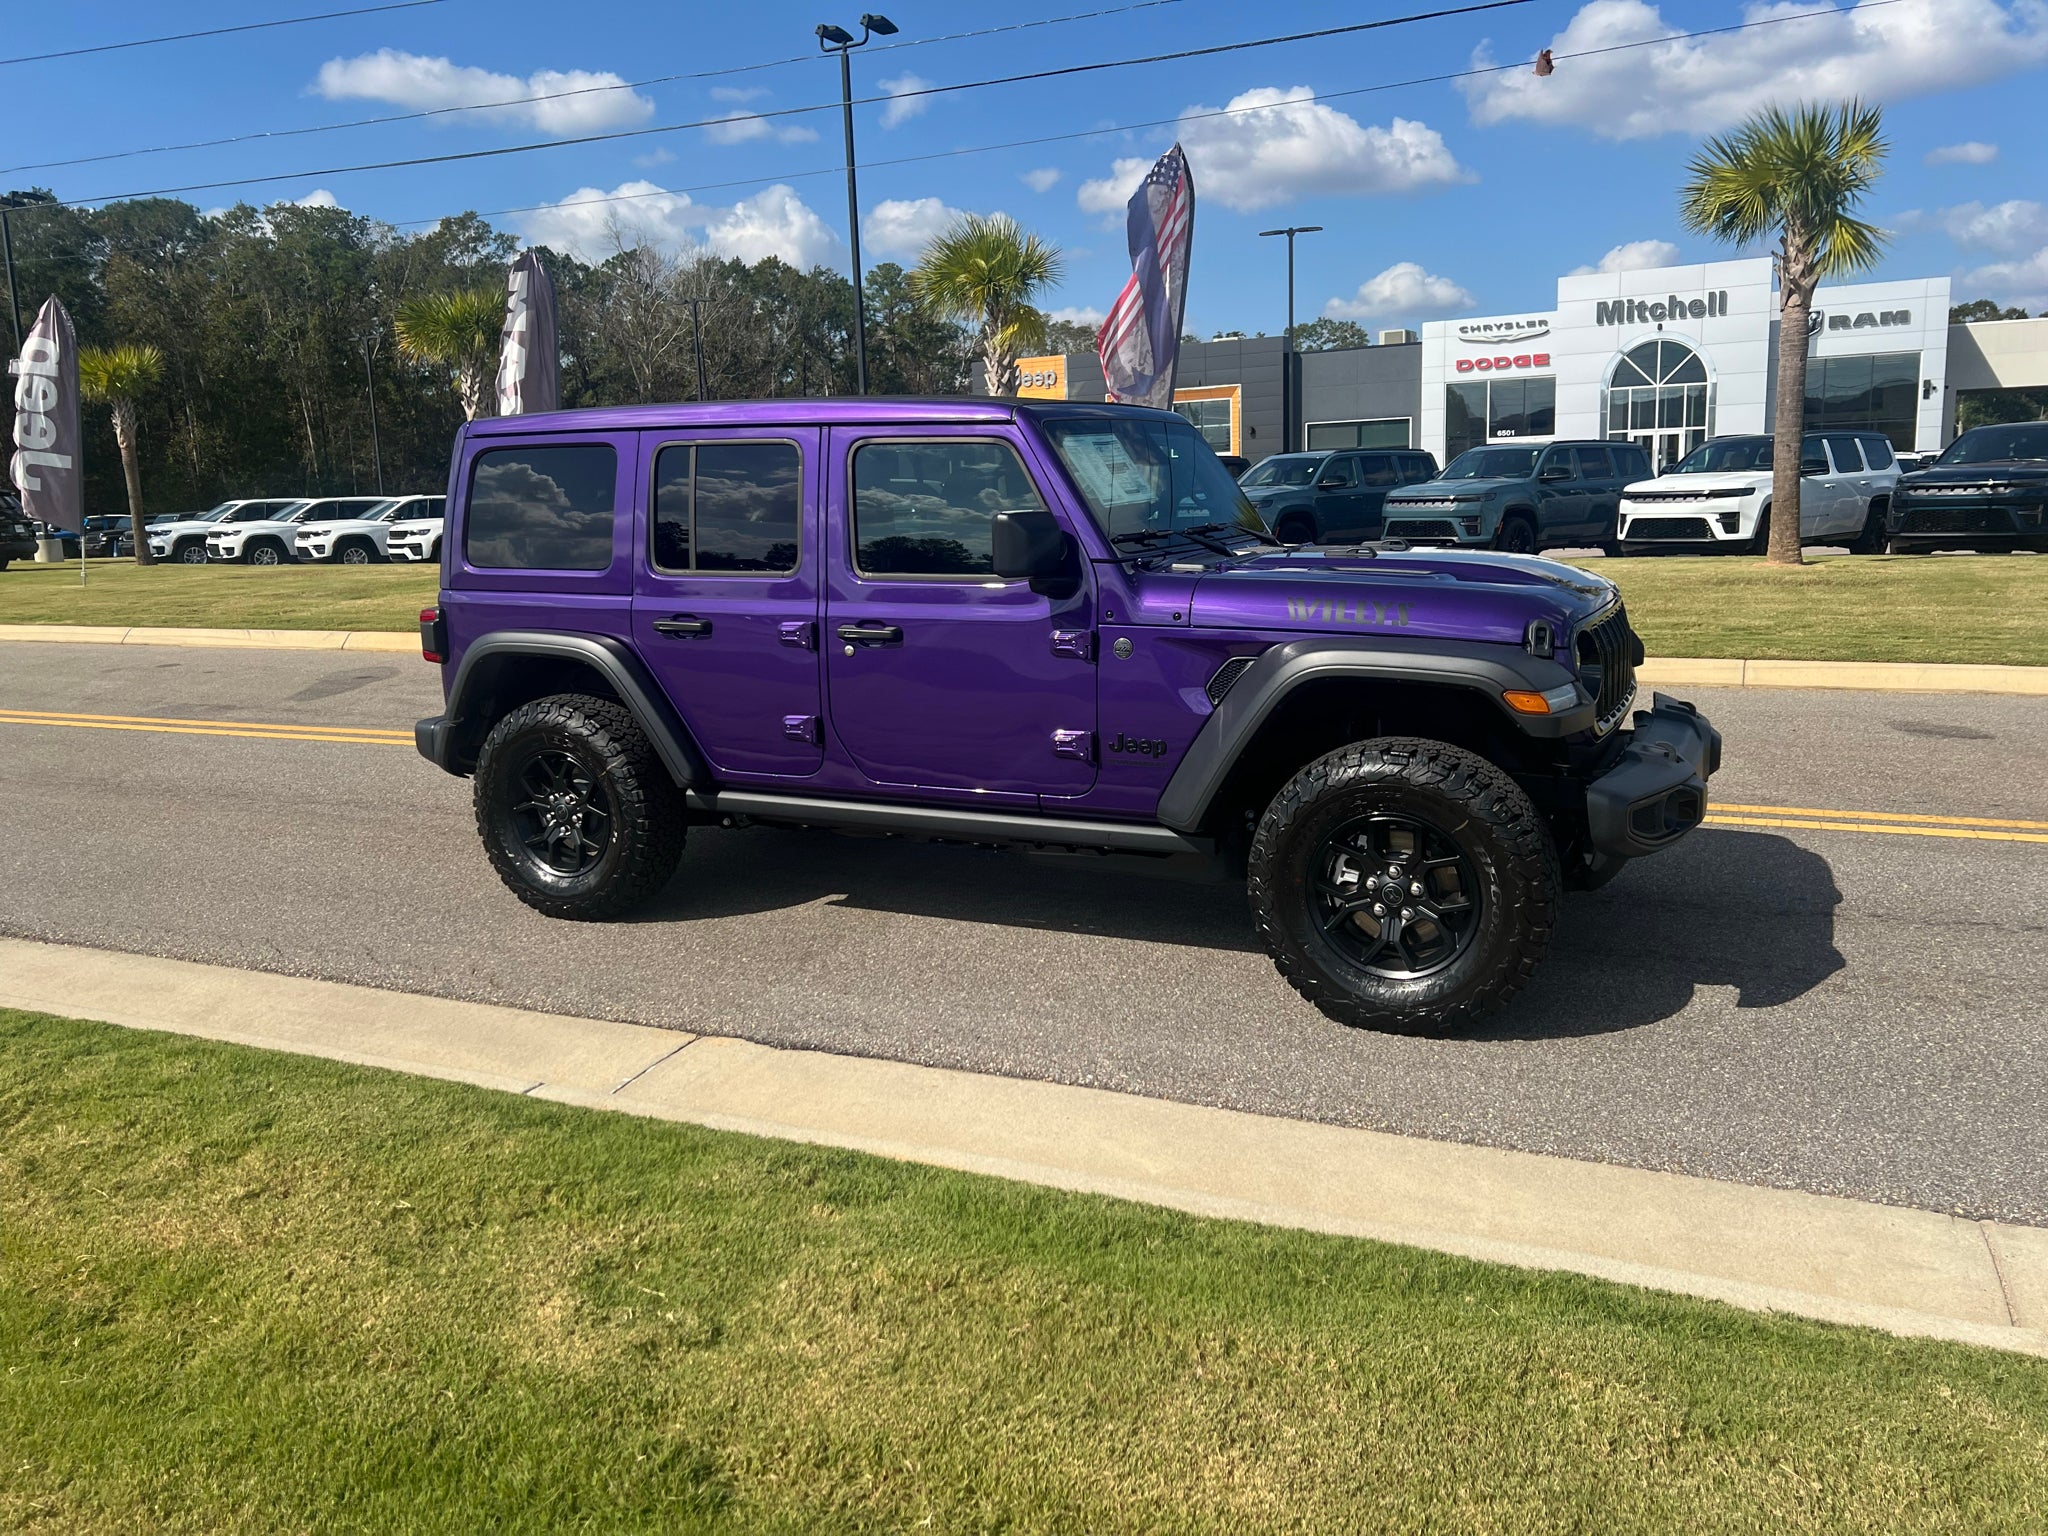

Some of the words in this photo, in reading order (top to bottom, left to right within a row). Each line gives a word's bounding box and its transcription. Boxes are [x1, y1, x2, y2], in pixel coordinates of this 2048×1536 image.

[1596, 290, 1728, 326] Mitchell
[1459, 319, 1549, 334] CHRYSLER
[1829, 309, 1912, 331] RAM
[1456, 353, 1551, 373] DODGE
[1497, 429, 1515, 437] 6501
[1288, 597, 1415, 626] WILLYS
[1108, 732, 1168, 759] Jeep
